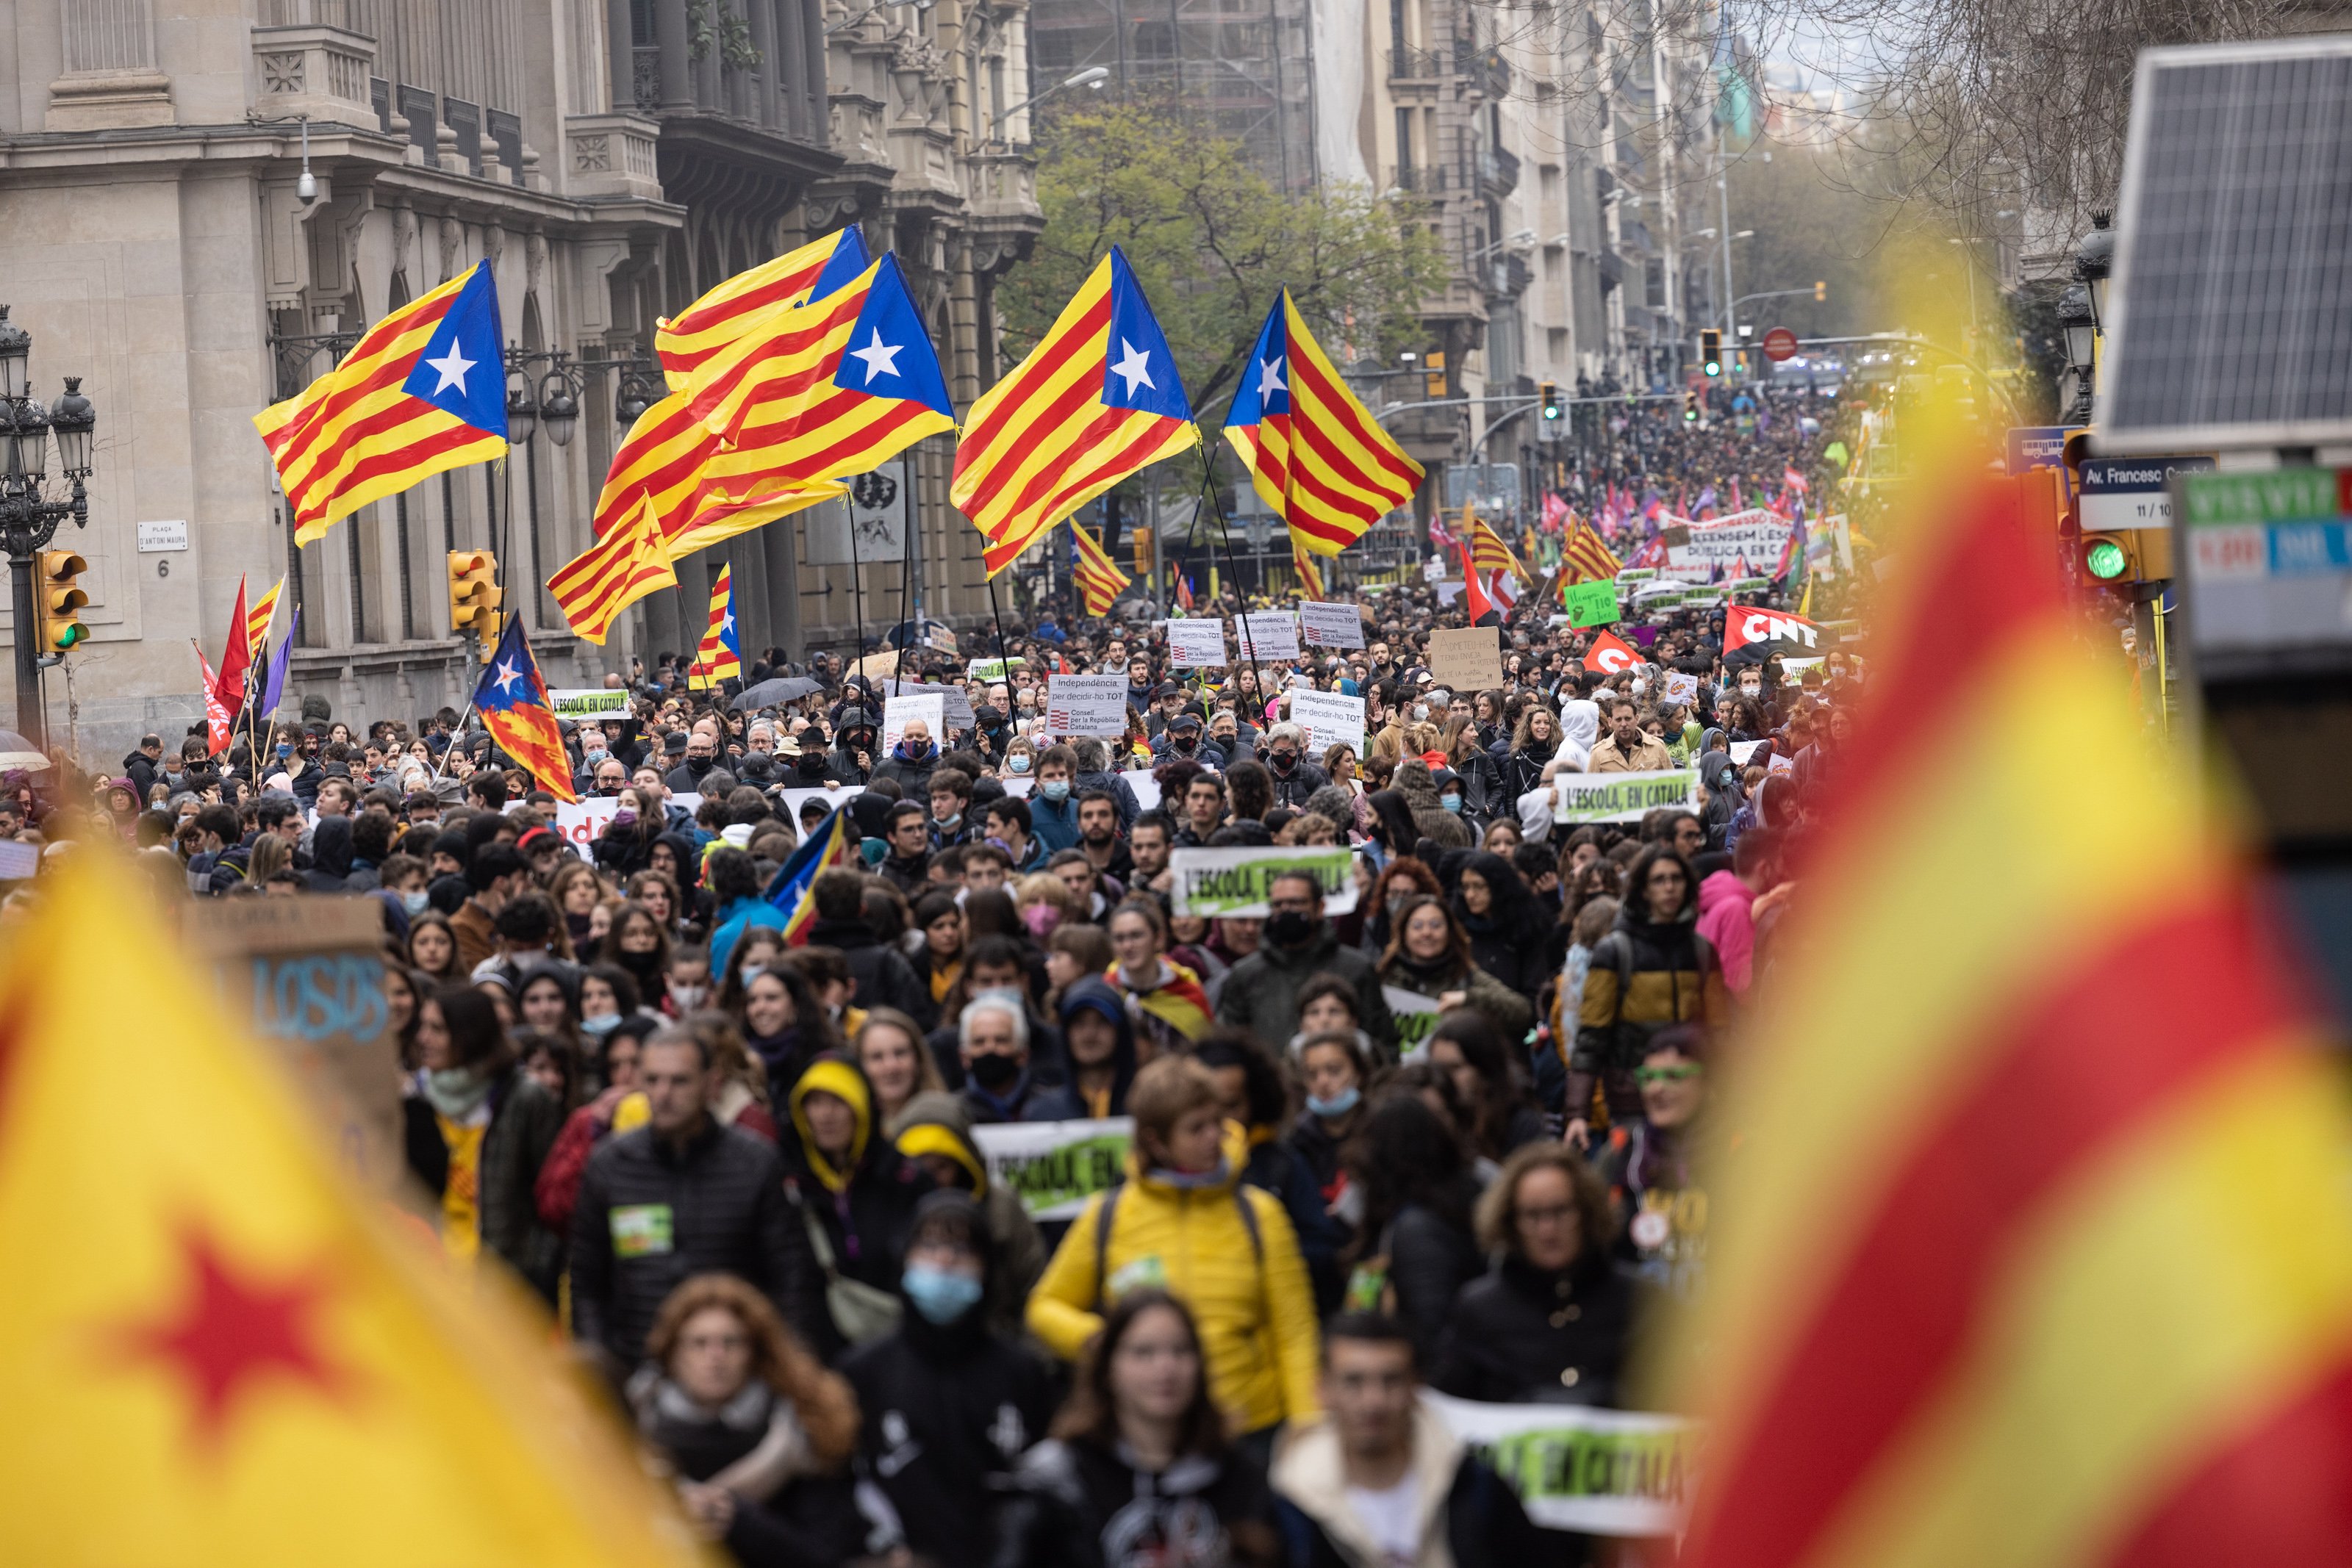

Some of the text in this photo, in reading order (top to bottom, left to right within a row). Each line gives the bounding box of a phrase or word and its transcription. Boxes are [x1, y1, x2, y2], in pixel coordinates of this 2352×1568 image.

[2086, 468, 2104, 485] Av.
[2107, 467, 2162, 483] Francesc
[140, 536, 186, 545] D'ANTONI MAURA
[1690, 530, 1756, 543] EFENSEM
[157, 559, 169, 578] 6
[1741, 613, 1818, 650] CNT
[1058, 678, 1119, 688] Independència,
[1052, 693, 1065, 702] per
[1066, 691, 1104, 700] decidir-ho
[553, 694, 625, 715] L'ESCOLA, EN CATALÀ
[927, 711, 940, 719] TOT
[1308, 708, 1344, 720] decidir-ho
[1345, 713, 1361, 723] TOT
[1313, 725, 1335, 734] Consell
[1567, 777, 1688, 813] L'ESCOLA, EN CATALÀ
[1185, 867, 1259, 902] L'ESCOLA,
